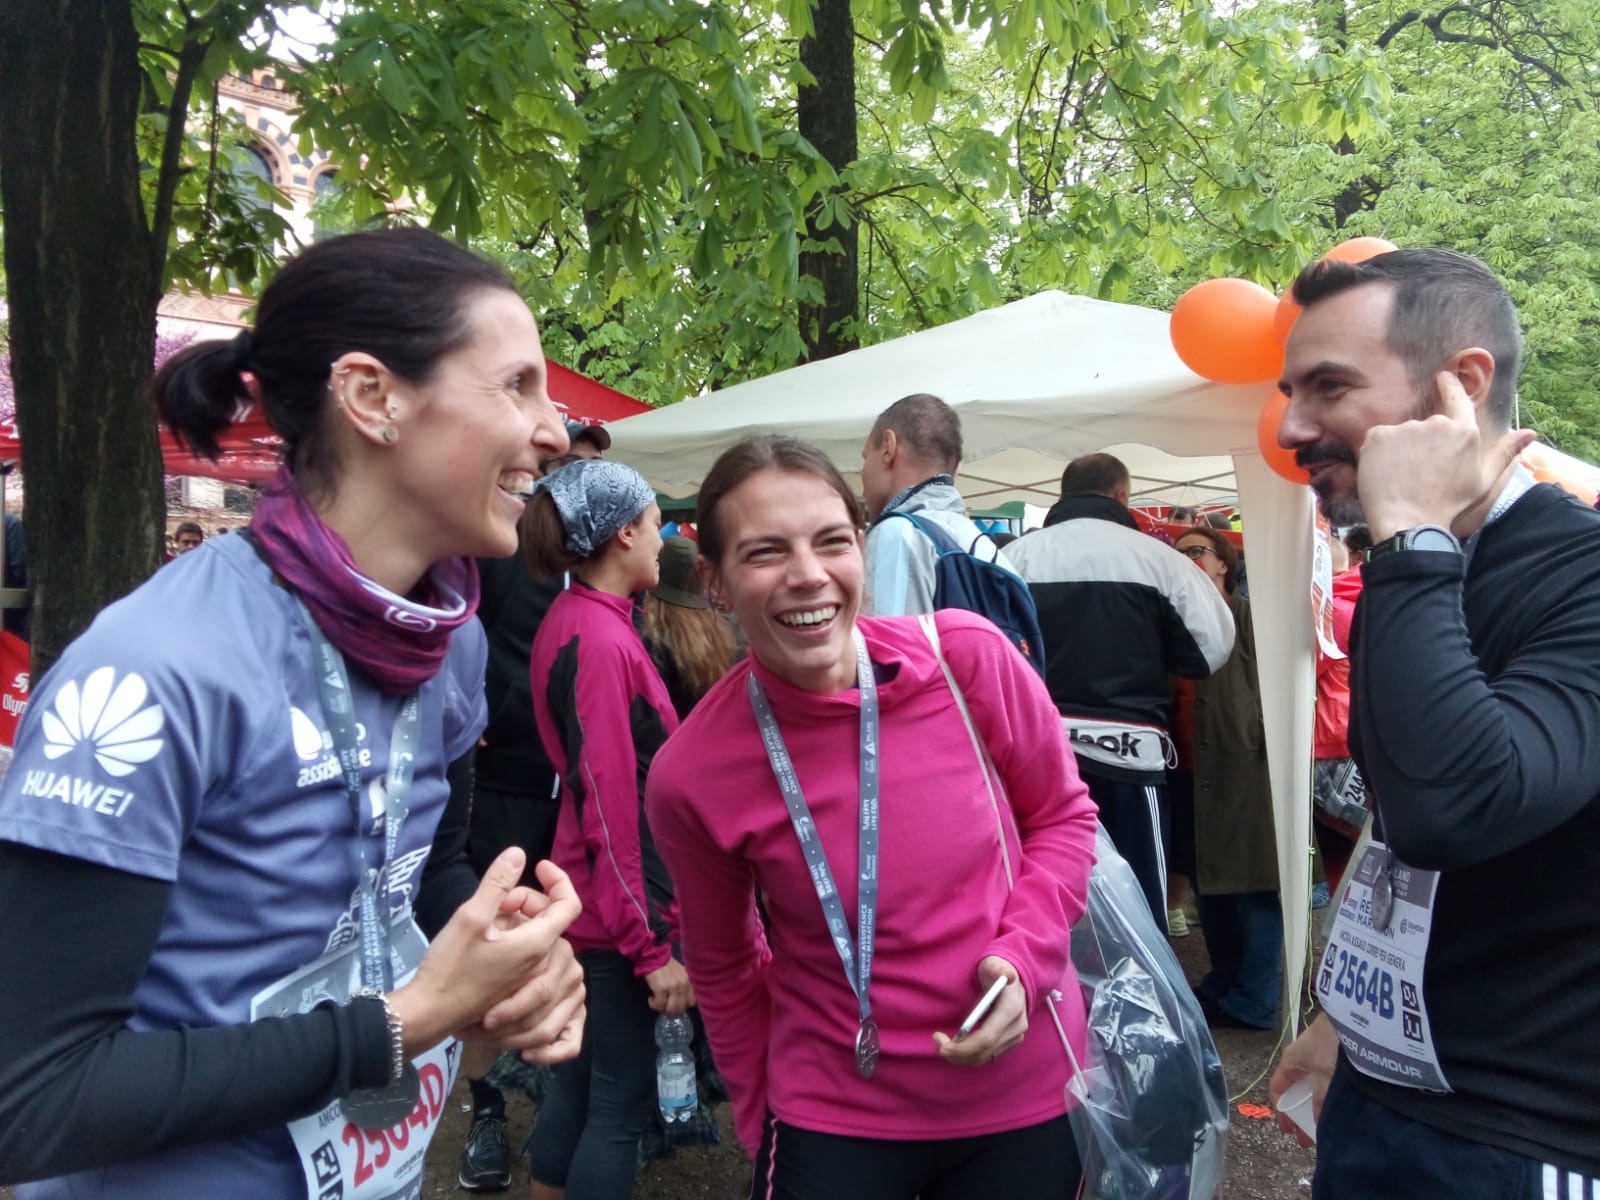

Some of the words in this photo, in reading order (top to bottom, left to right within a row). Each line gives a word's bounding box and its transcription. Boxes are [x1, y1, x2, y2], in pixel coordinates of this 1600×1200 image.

[771, 751, 790, 793] MARATHON
[778, 751, 798, 795] ASSISTANCE
[21, 770, 134, 817] HUAWEI
[1356, 913, 1395, 939] MARON
[1334, 949, 1394, 1020] 2564B
[1360, 1047, 1422, 1078] ARMOUR
[318, 1104, 341, 1129] ANCO
